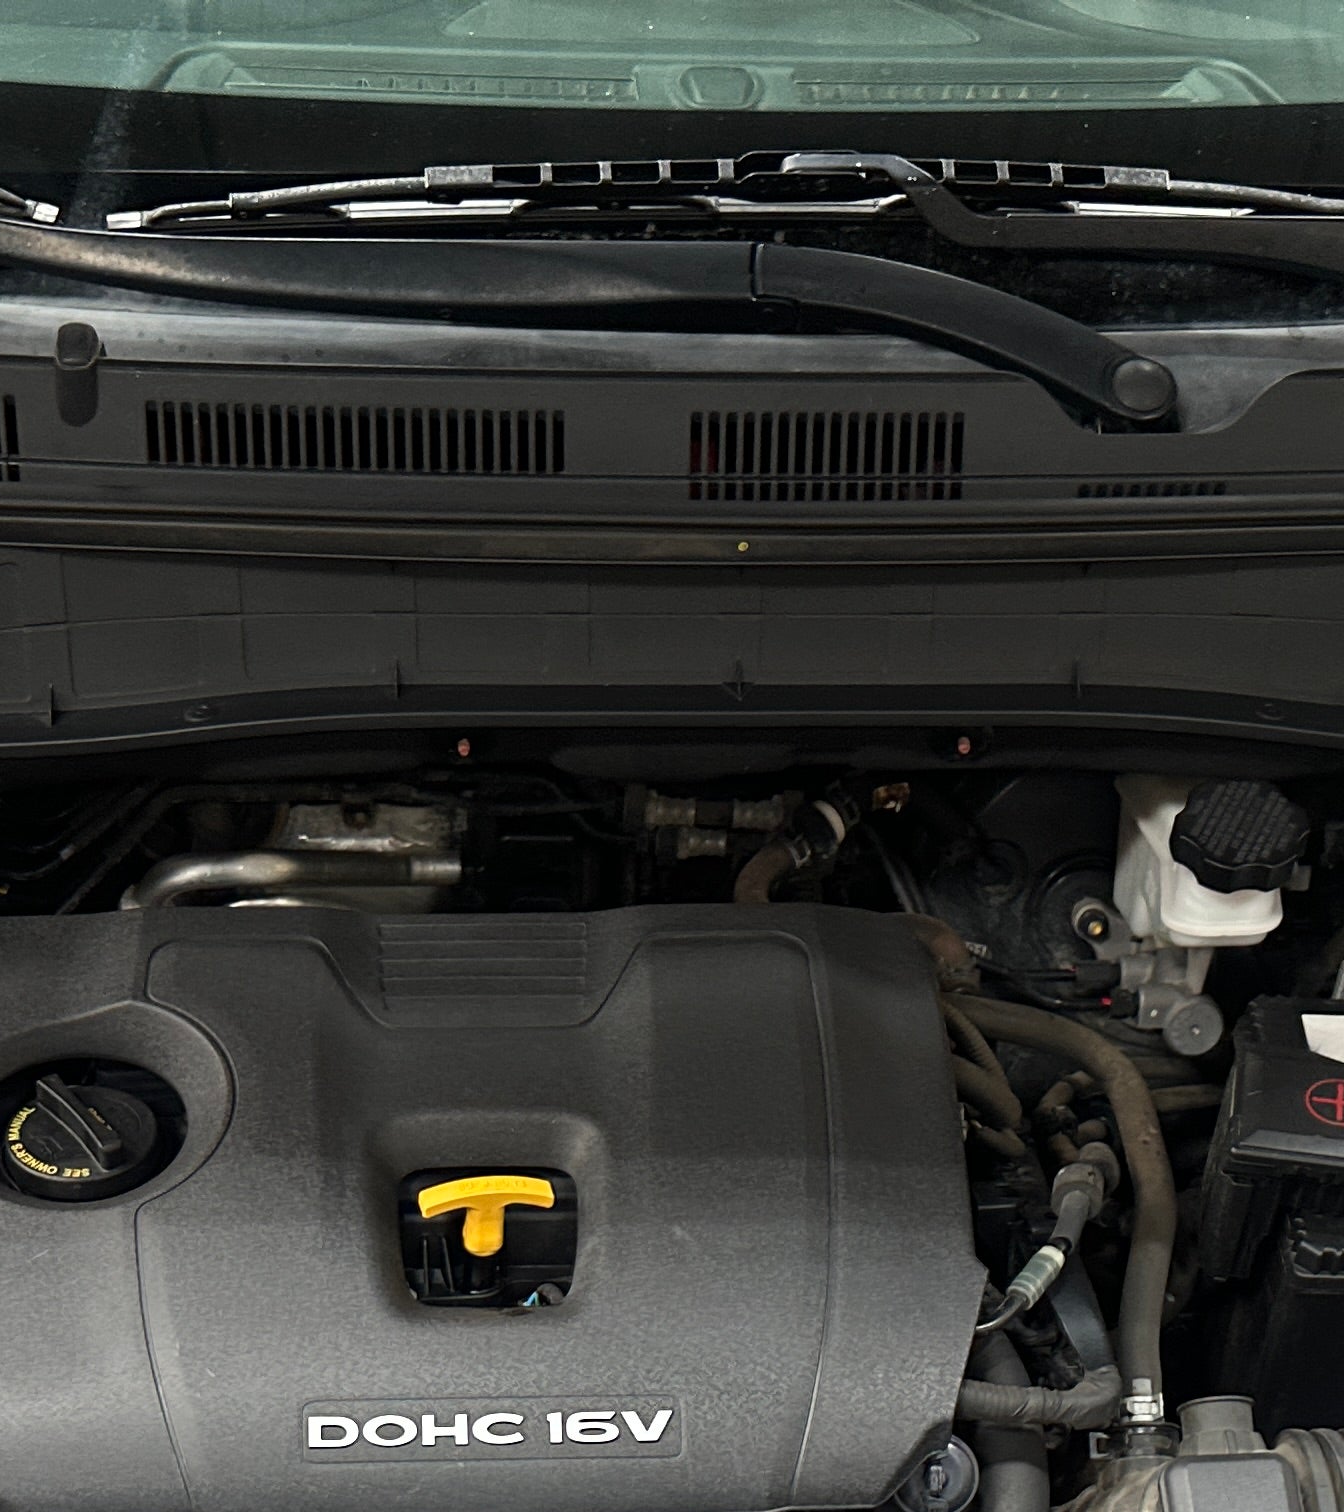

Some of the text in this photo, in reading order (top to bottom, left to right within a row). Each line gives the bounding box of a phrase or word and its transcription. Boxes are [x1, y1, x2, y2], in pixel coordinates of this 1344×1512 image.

[7, 1106, 37, 1142] MANUAL
[62, 1167, 90, 1178] SEE
[307, 1409, 674, 1449] DOHC 16V
